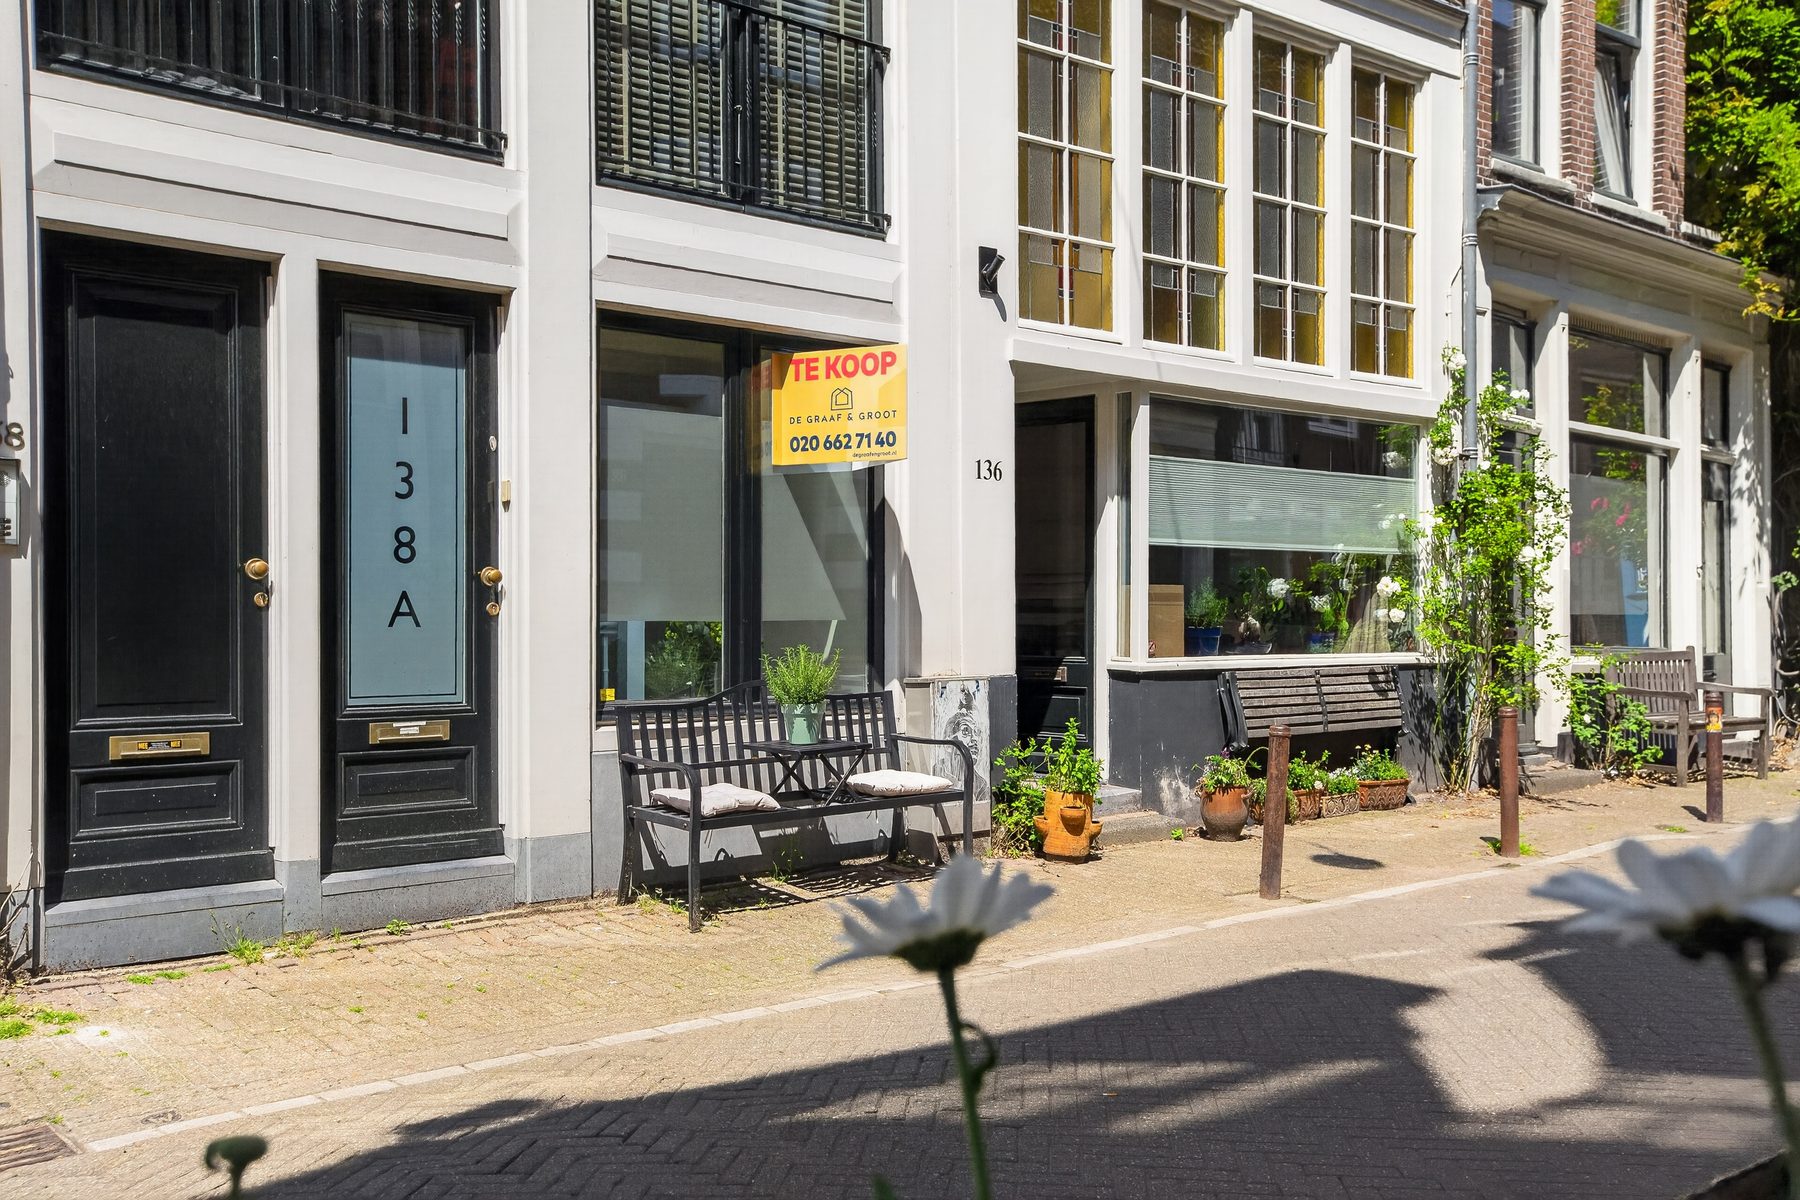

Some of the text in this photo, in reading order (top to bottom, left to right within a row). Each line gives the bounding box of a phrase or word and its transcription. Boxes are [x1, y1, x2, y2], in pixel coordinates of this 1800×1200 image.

[791, 351, 897, 382] TE KOOP
[789, 410, 897, 425] DE GRAAF & GROOT
[790, 435, 820, 453] 020
[823, 433, 852, 451] 662
[975, 459, 1003, 482] 136
